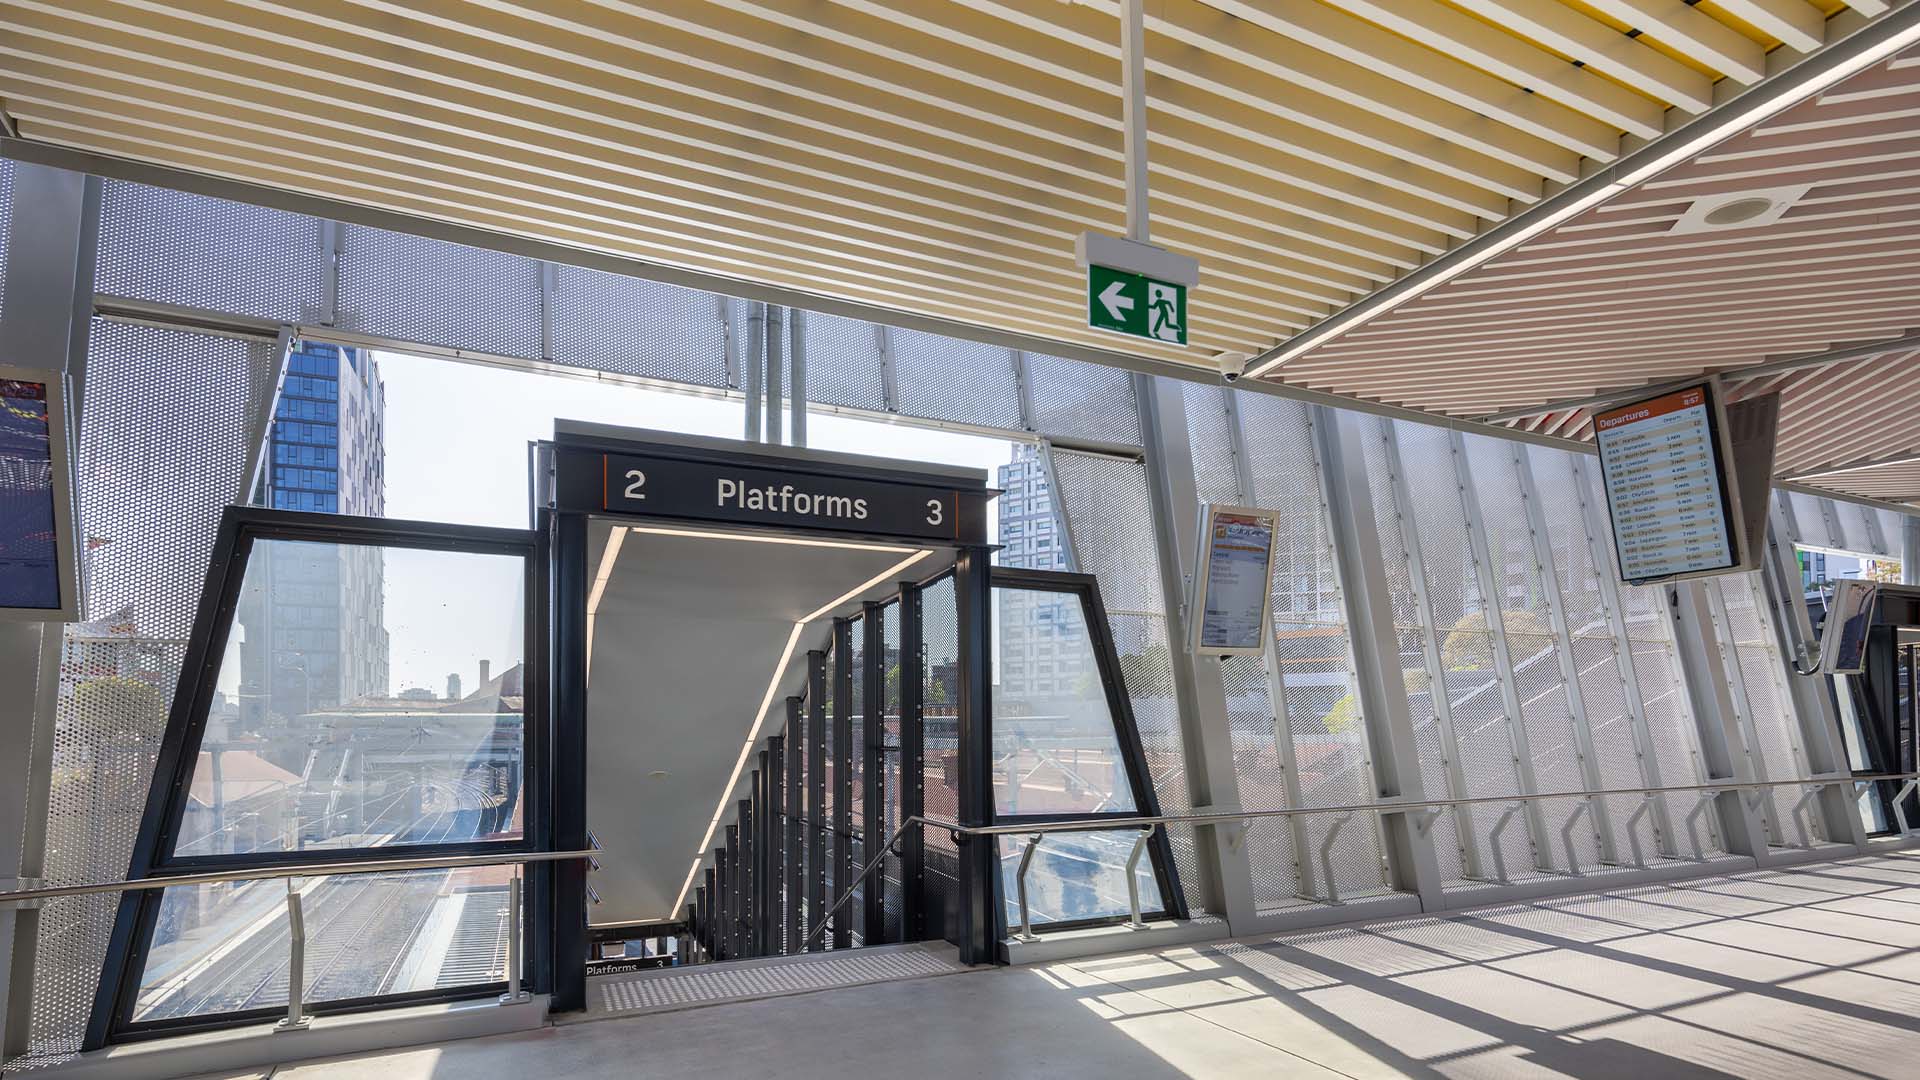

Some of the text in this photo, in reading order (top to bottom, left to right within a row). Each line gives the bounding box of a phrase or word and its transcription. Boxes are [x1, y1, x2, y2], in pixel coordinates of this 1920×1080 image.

[1599, 408, 1649, 427] Departures
[624, 469, 943, 526] 2 Platforms 3
[586, 960, 664, 975] Platforms 3
